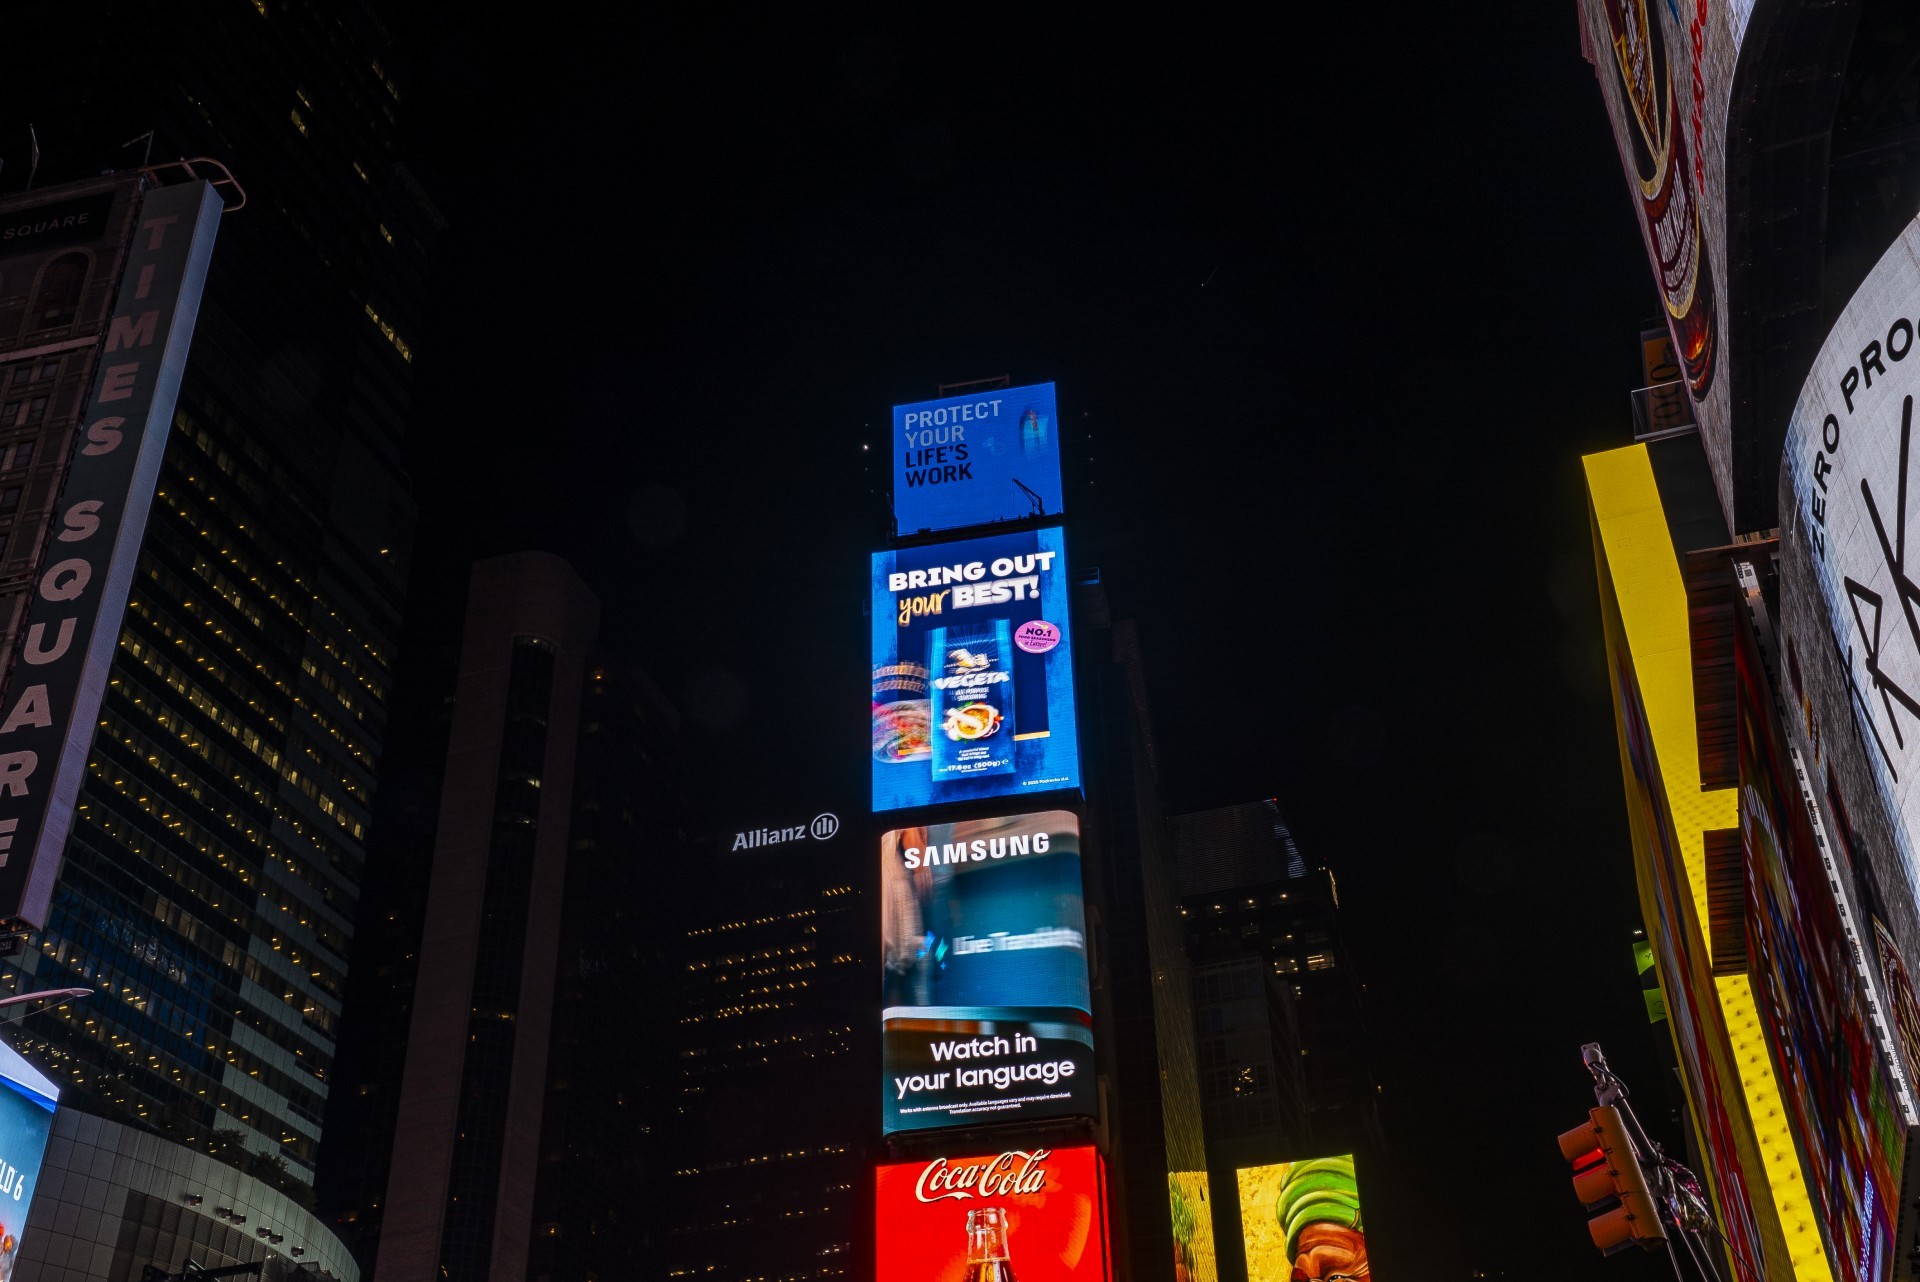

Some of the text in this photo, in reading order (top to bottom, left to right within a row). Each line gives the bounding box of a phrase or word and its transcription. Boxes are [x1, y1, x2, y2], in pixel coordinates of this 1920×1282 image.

[2, 211, 89, 240] SQUARE
[82, 214, 180, 457] TIMES
[904, 399, 1003, 431] PROTECT
[904, 425, 965, 449] YOUR
[1811, 317, 1920, 563] ZERO PRO
[905, 443, 969, 469] LIFE'S
[904, 462, 973, 488] WORK
[888, 551, 1056, 592] BRING OUT
[898, 575, 1041, 627] your BEST!
[1025, 627, 1052, 637] NO.1
[934, 671, 1010, 690] VEGETA
[731, 825, 806, 852] Allianz
[903, 832, 1050, 869] SAMSUNG
[930, 1032, 1037, 1062] Watch in
[894, 1060, 1076, 1100] your language
[0, 1158, 24, 1201] LD 6
[915, 1148, 1052, 1203] Coca-Cola
